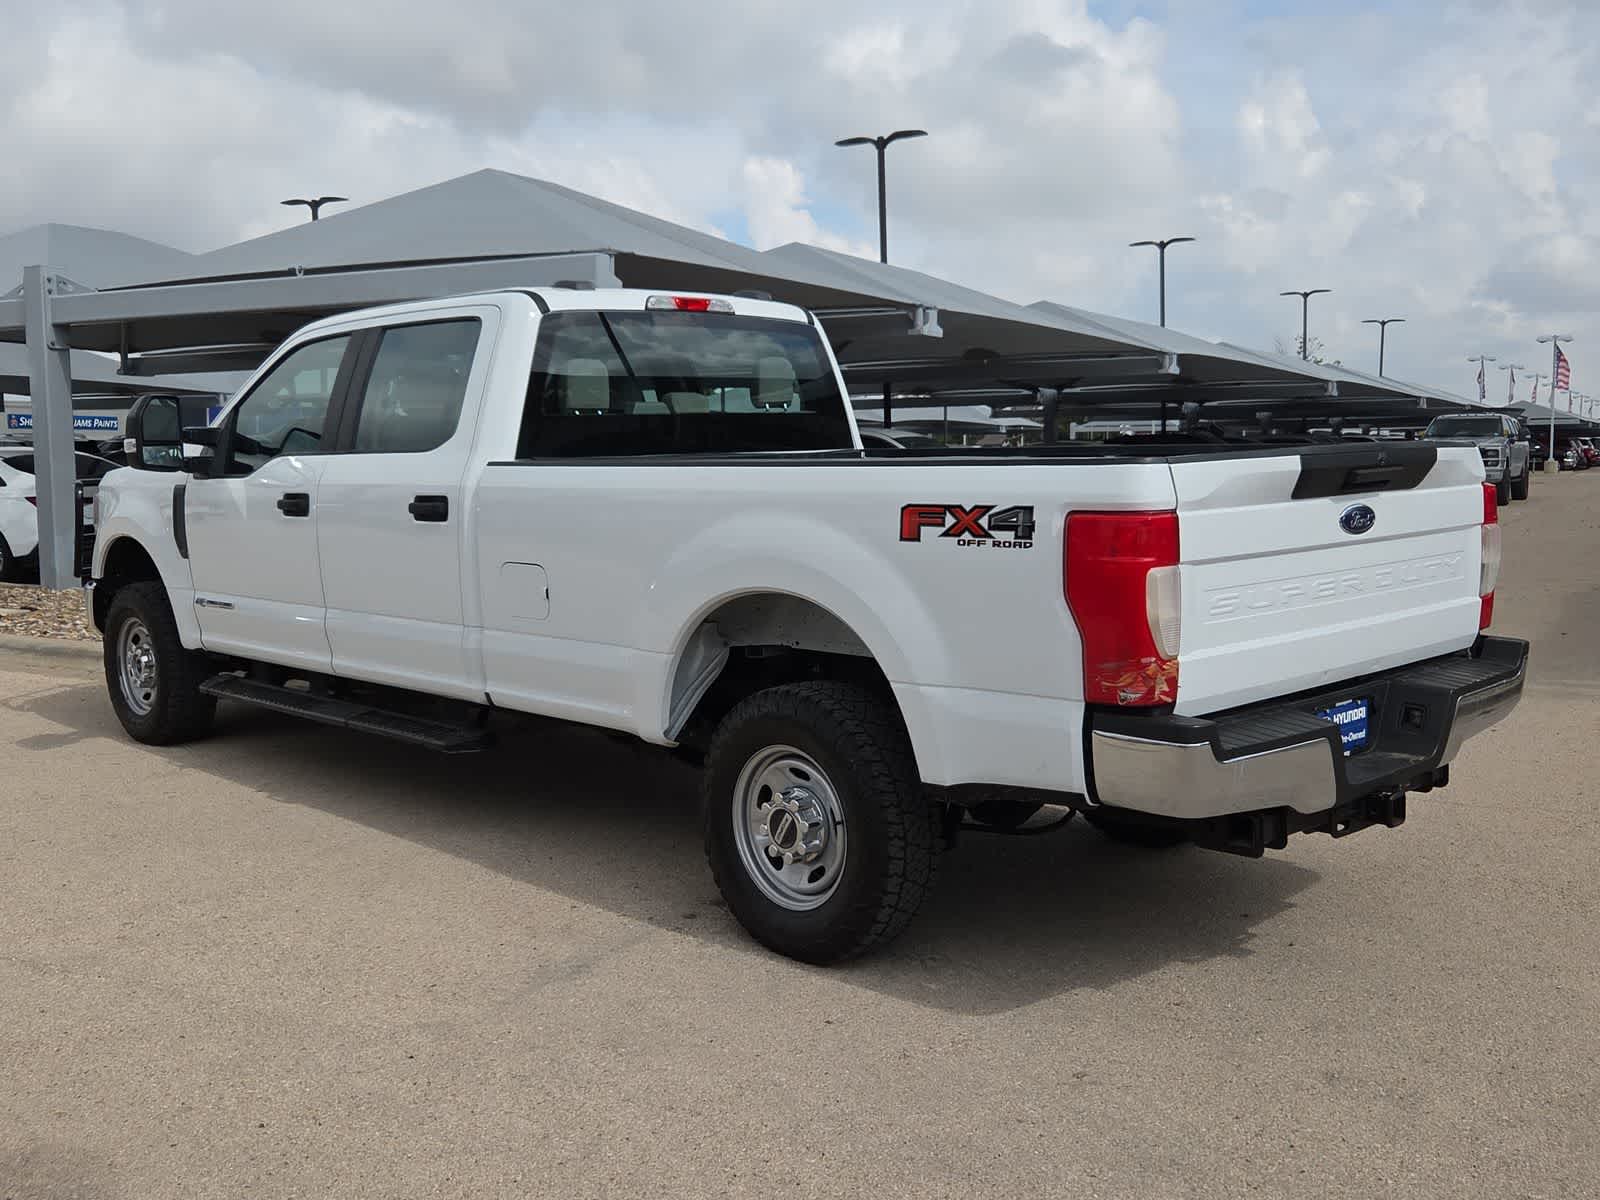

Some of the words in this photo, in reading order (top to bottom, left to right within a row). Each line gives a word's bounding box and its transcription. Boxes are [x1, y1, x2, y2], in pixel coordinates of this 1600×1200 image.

[93, 418, 118, 428] PAINTS
[899, 503, 1035, 542] FX4
[957, 539, 986, 547] OFF
[992, 540, 1033, 549] ROAD
[1209, 574, 1370, 617] SUPER
[1375, 555, 1464, 589] DUTY
[1333, 706, 1366, 725] HYUNDAI
